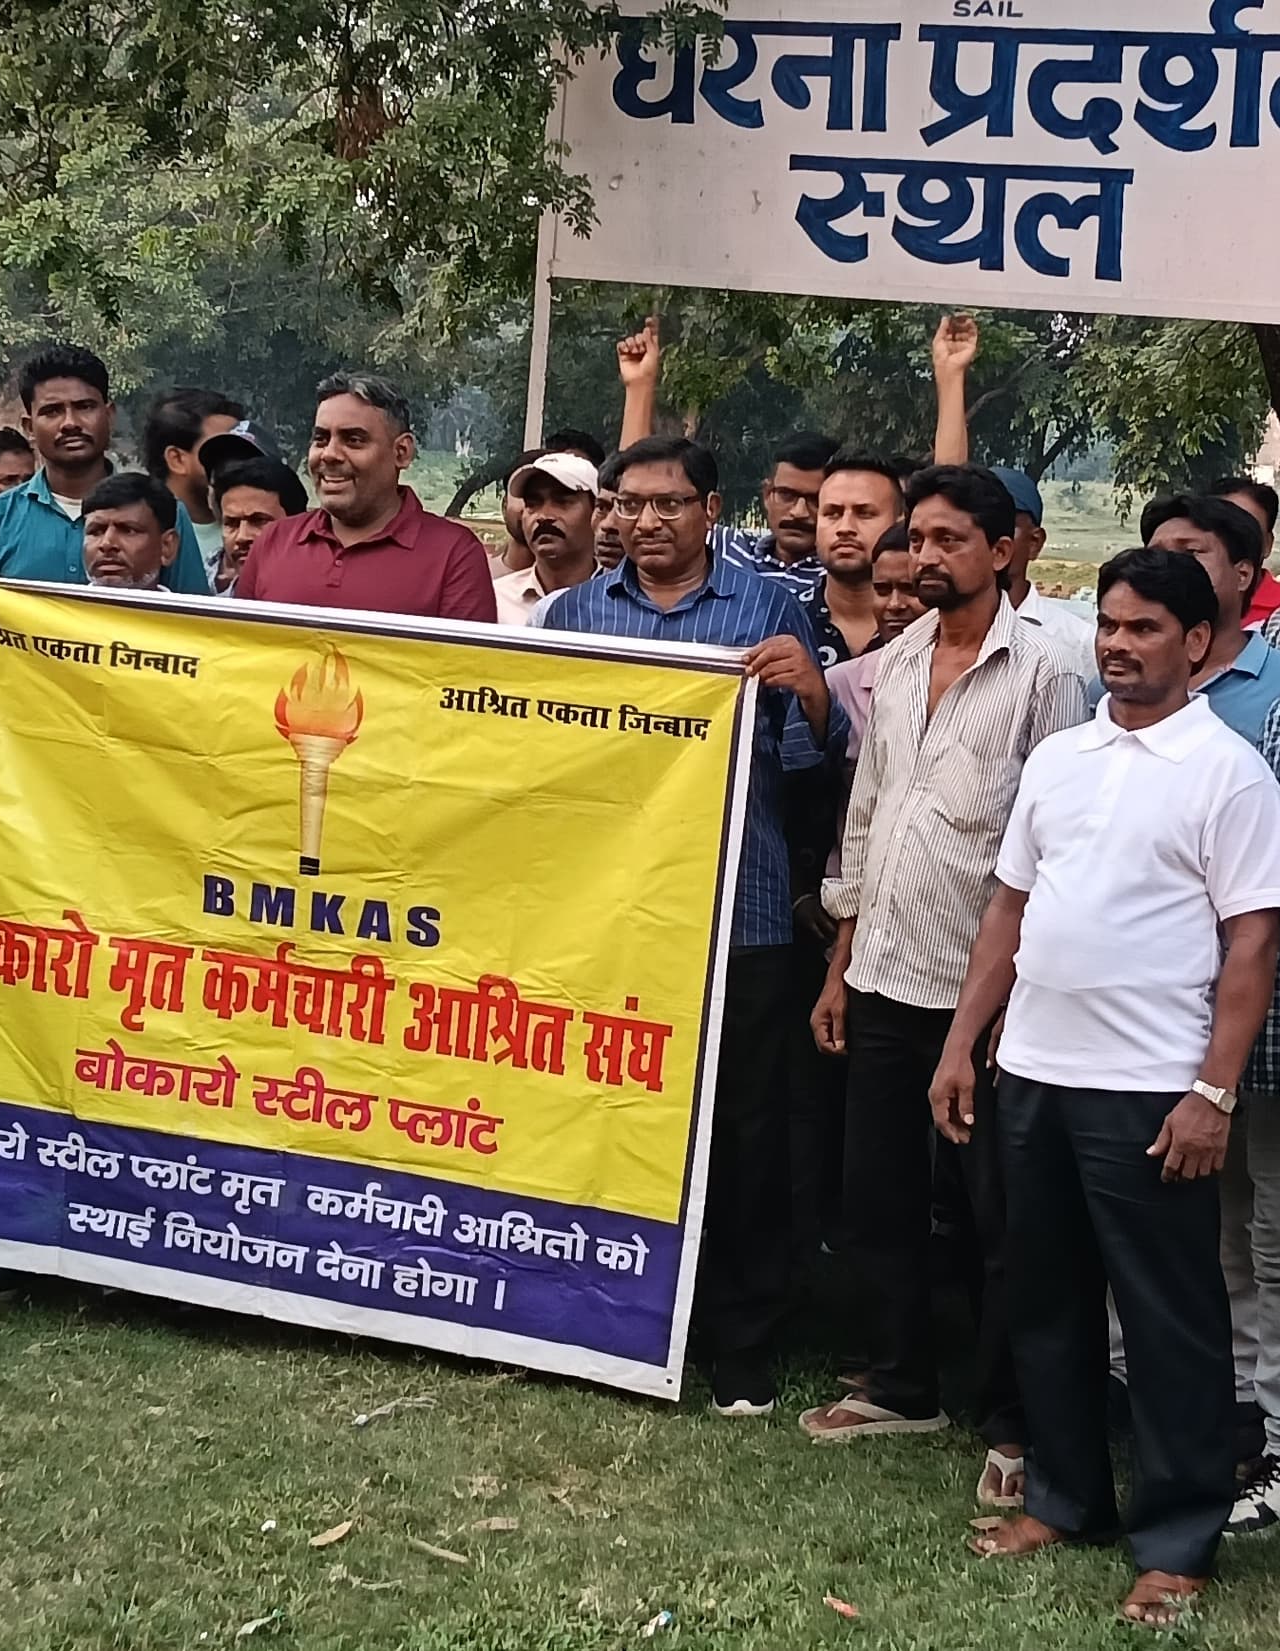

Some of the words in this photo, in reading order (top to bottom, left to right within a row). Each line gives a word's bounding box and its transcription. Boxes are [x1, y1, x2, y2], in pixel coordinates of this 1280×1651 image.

[953, 0, 1024, 17] SAIL
[789, 154, 1135, 282] स्थल
[32, 634, 105, 665] एकता
[439, 686, 531, 719] आश्रित
[536, 698, 613, 730] एकता
[108, 935, 195, 1032] मृत
[201, 941, 396, 1045] कर्मचारी
[403, 972, 575, 1076] आश्रित
[582, 995, 674, 1093] संघ
[75, 1038, 241, 1109] बोकारो
[251, 1065, 379, 1132] स्टील
[387, 1097, 505, 1156] प्लांट
[36, 1131, 125, 1180] स्टील
[129, 1154, 216, 1196] प्लांट
[220, 1168, 287, 1214] मृत
[305, 1181, 449, 1238] कर्मचारी
[452, 1210, 590, 1262] आश्रितो
[595, 1232, 651, 1277] को
[67, 1202, 157, 1249] स्थाई
[162, 1210, 311, 1275] नियोजन
[314, 1240, 386, 1291] देना
[391, 1257, 480, 1307] होगा
